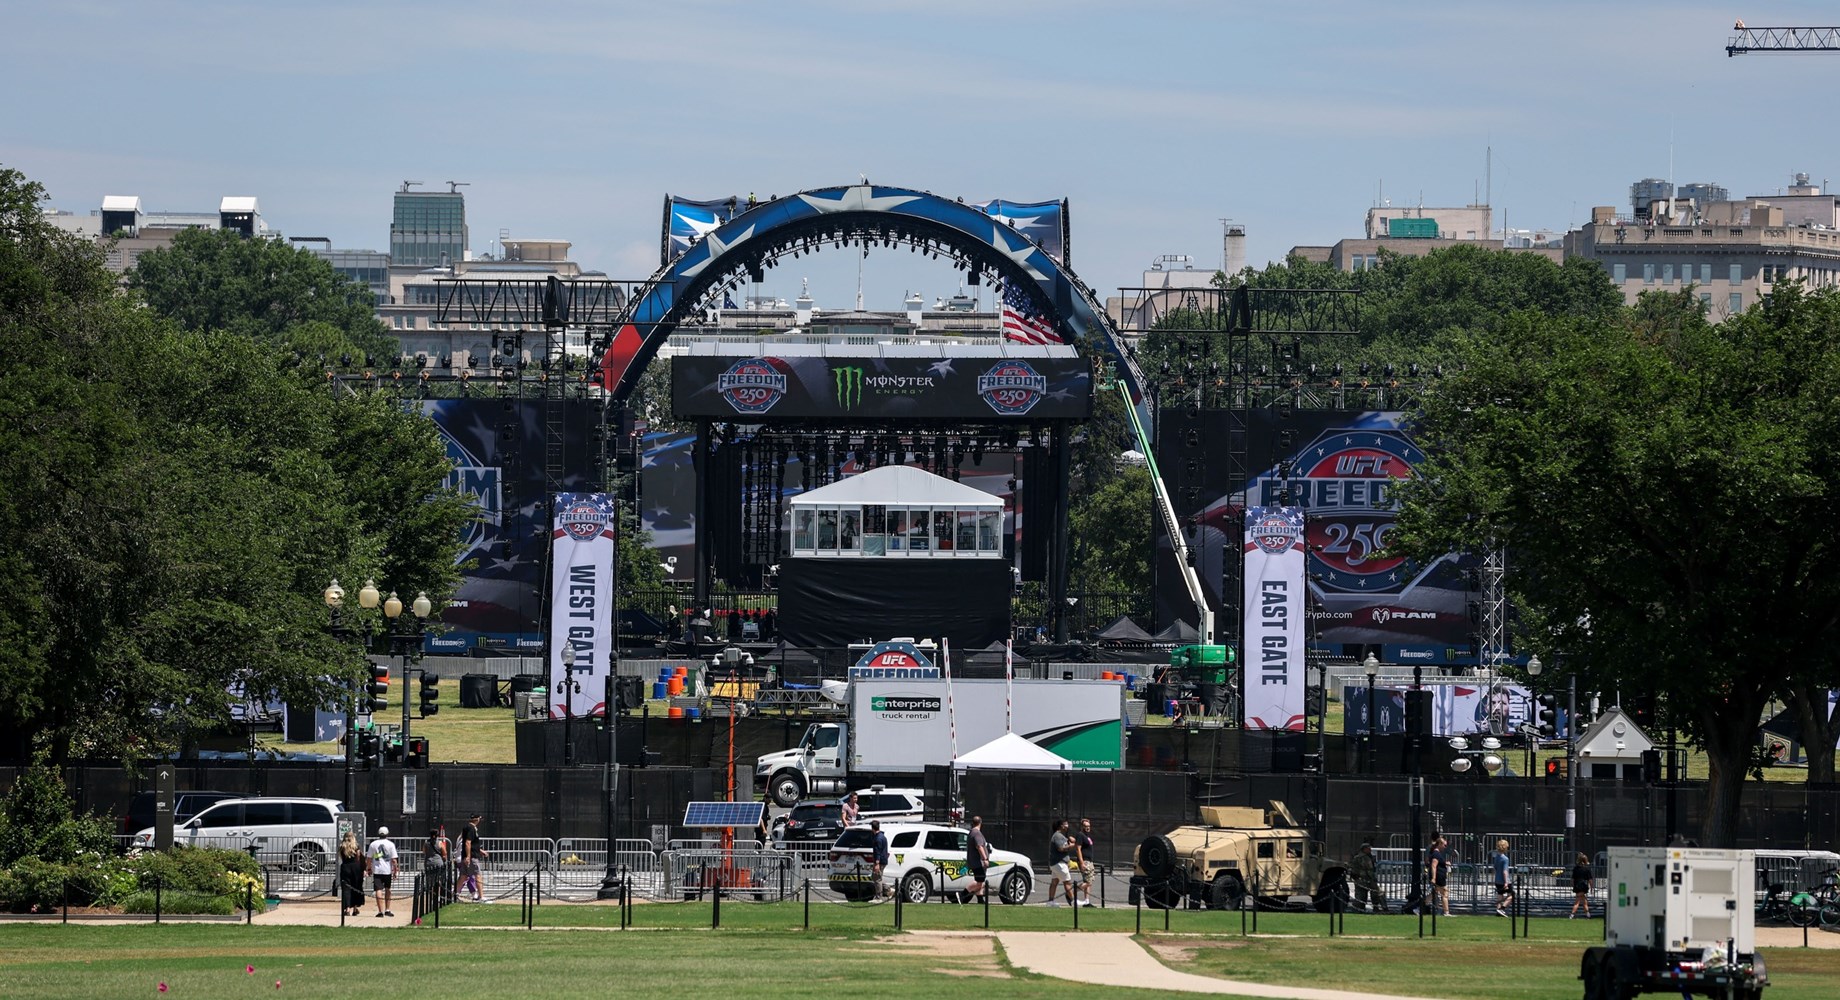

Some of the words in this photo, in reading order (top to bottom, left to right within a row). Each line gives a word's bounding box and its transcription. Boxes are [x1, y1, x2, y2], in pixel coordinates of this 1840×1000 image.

[719, 375, 785, 390] FREEDOM
[865, 375, 934, 388] MONSTER
[979, 376, 1045, 391] FREEDOM
[739, 388, 766, 402] 250
[1000, 390, 1026, 404] 250
[1335, 456, 1393, 475] UFC
[560, 514, 608, 524] FREEDOM
[574, 524, 594, 534] 250
[1250, 526, 1299, 537] FREEDOM
[1265, 537, 1285, 547] 250
[569, 565, 595, 621] WEST
[1262, 581, 1287, 630] EAST
[569, 627, 594, 675] GATE
[882, 655, 907, 665] UFC
[1262, 636, 1287, 685] GATE
[876, 700, 940, 709] enterprise
